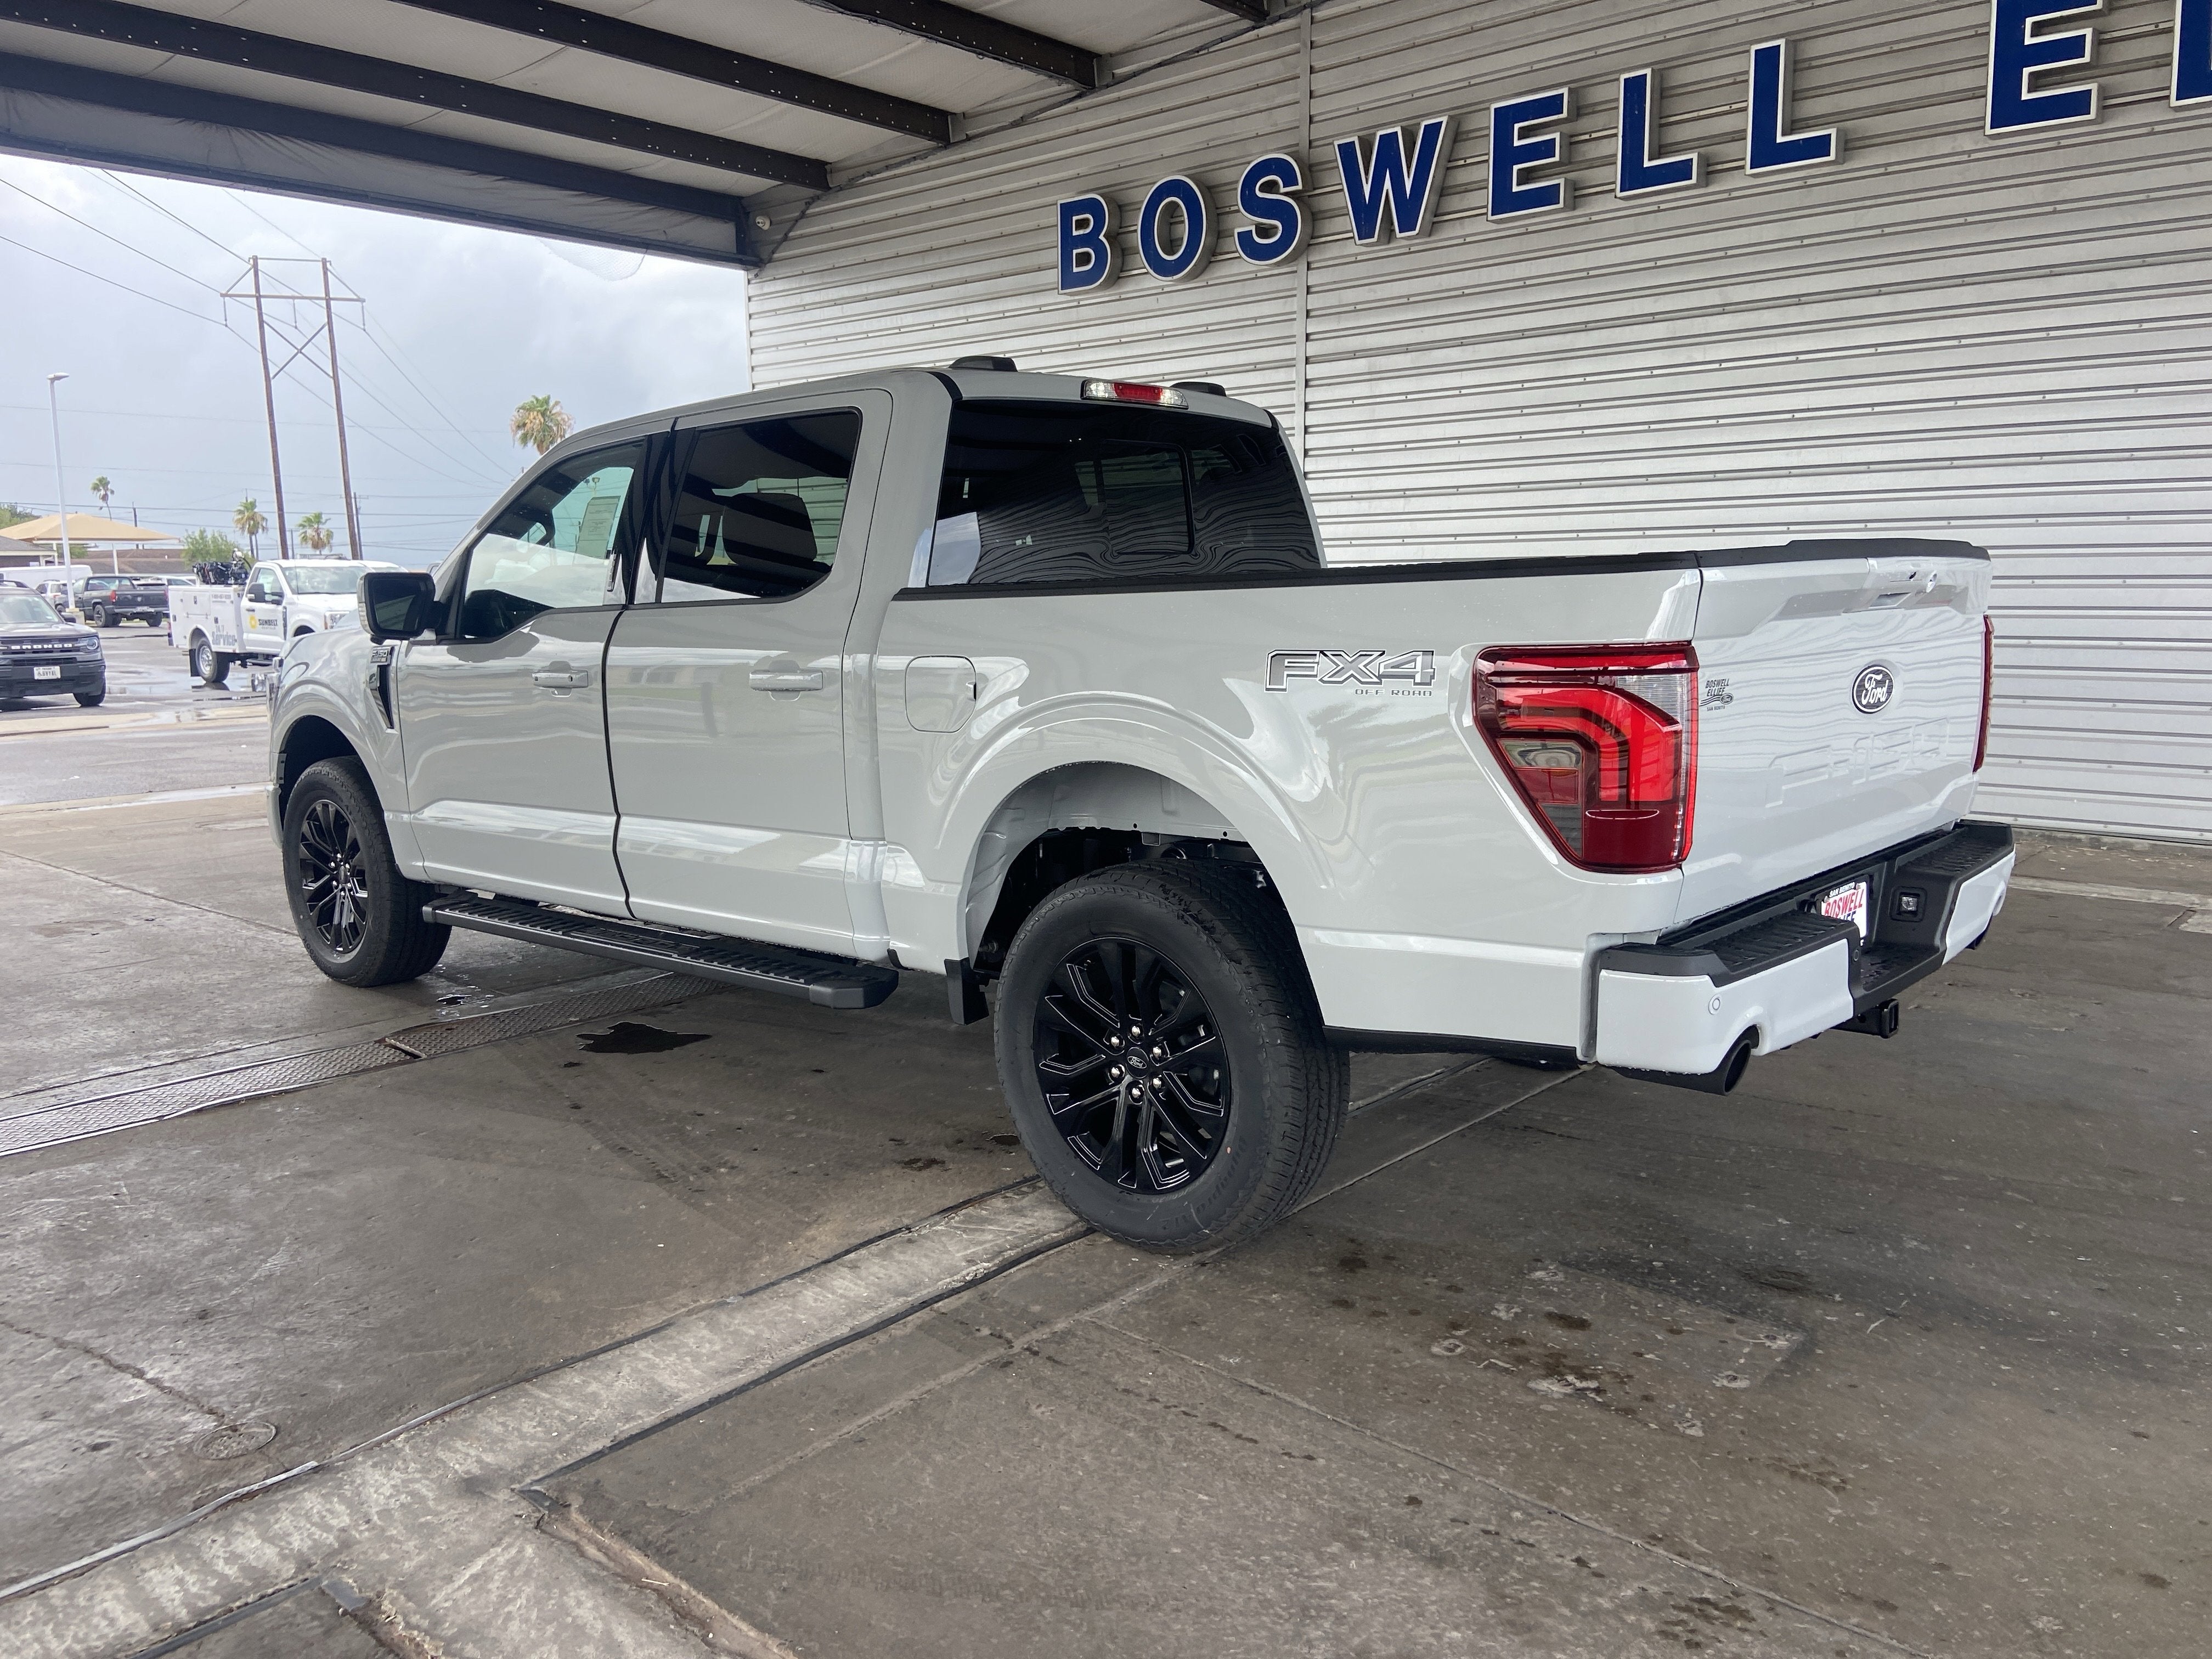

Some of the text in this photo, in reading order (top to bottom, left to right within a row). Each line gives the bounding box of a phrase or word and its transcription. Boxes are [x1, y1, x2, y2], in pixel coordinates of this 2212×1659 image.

[1057, 38, 1843, 296] BOSWELL
[212, 631, 236, 646] Service
[1265, 650, 1436, 693] FX4
[1705, 678, 1730, 689] BOSWELL
[1861, 674, 1889, 705] Ford
[1829, 882, 1855, 898] SAN BENITO
[1825, 889, 1865, 919] BOSWELL
[1131, 1057, 1144, 1068] Ford
